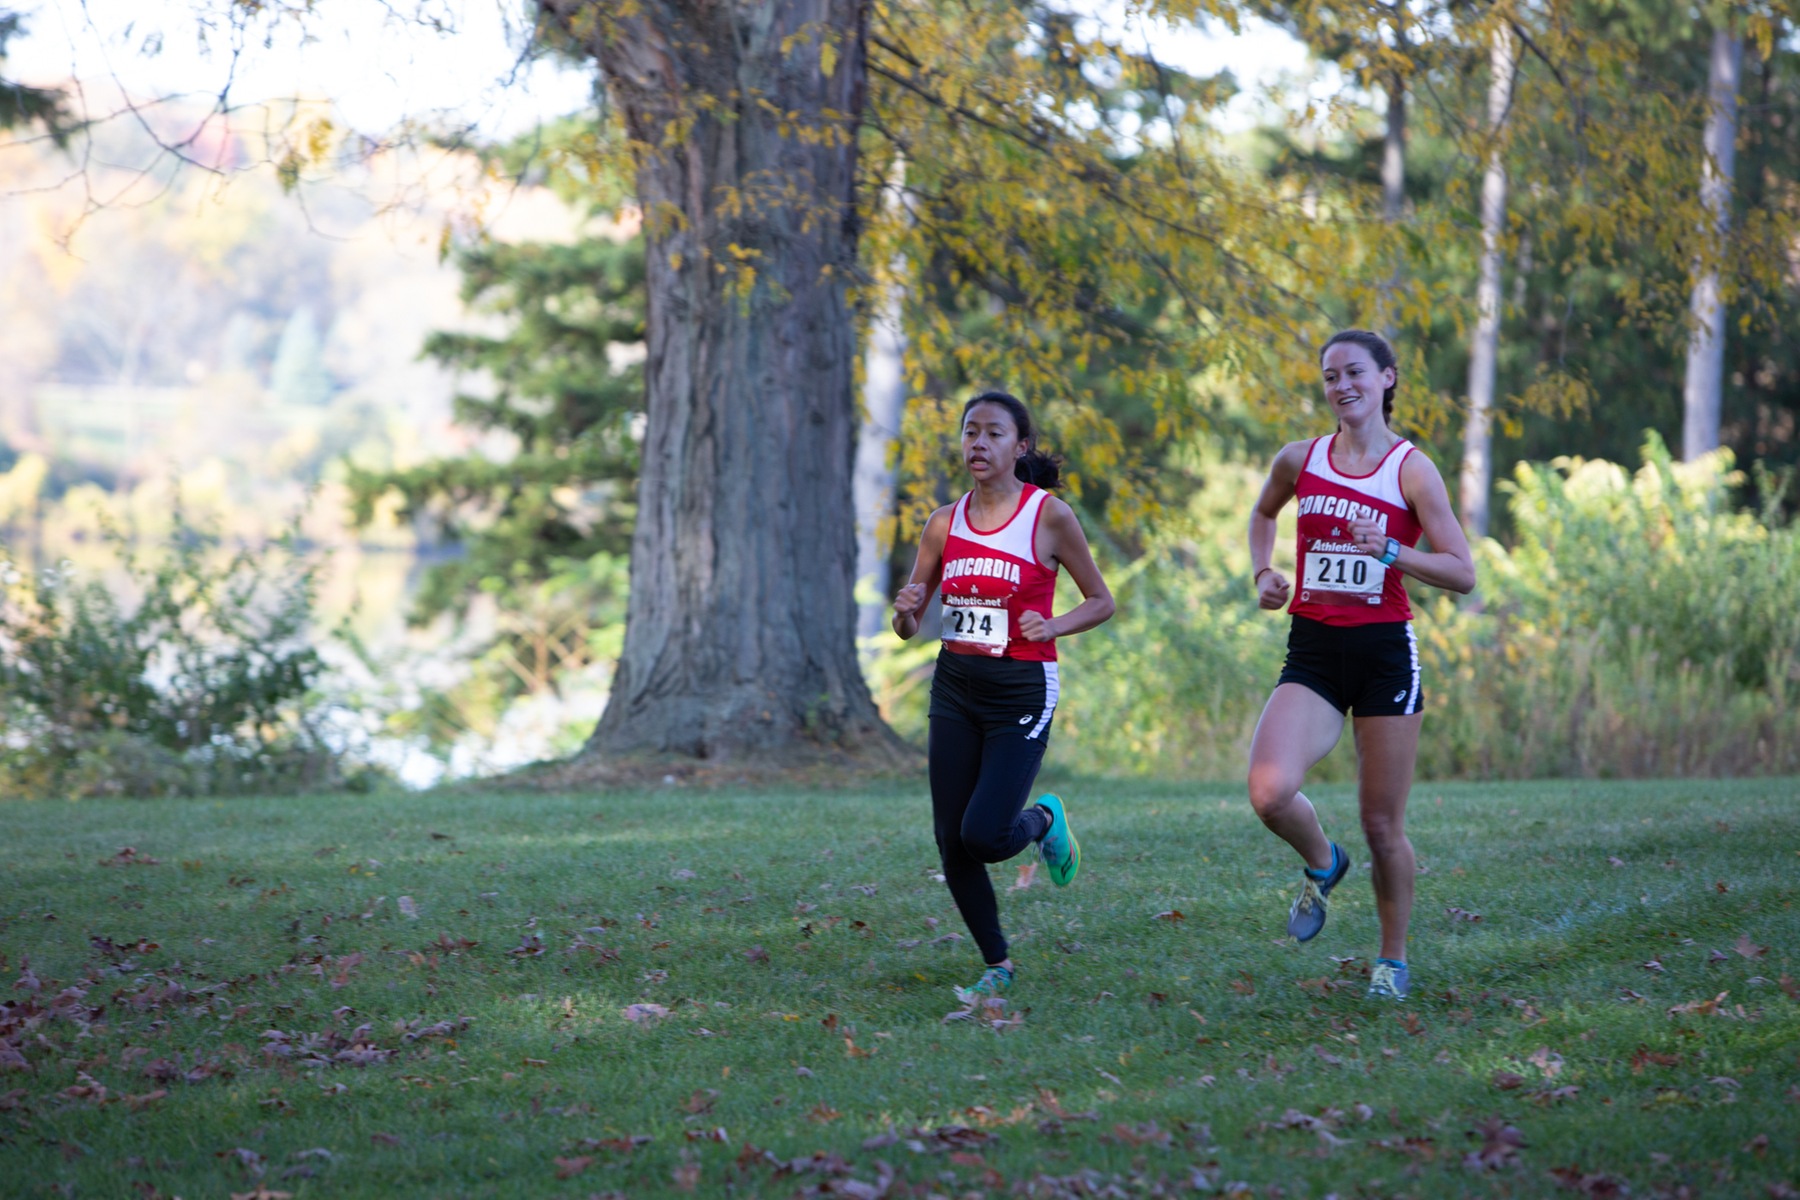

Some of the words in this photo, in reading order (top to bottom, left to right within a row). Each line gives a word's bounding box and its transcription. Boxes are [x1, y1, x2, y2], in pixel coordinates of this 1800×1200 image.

[942, 558, 1020, 585] CONCORDIA
[1318, 557, 1367, 585] 210
[946, 595, 1001, 607] Athletic.net
[952, 610, 993, 636] 214
